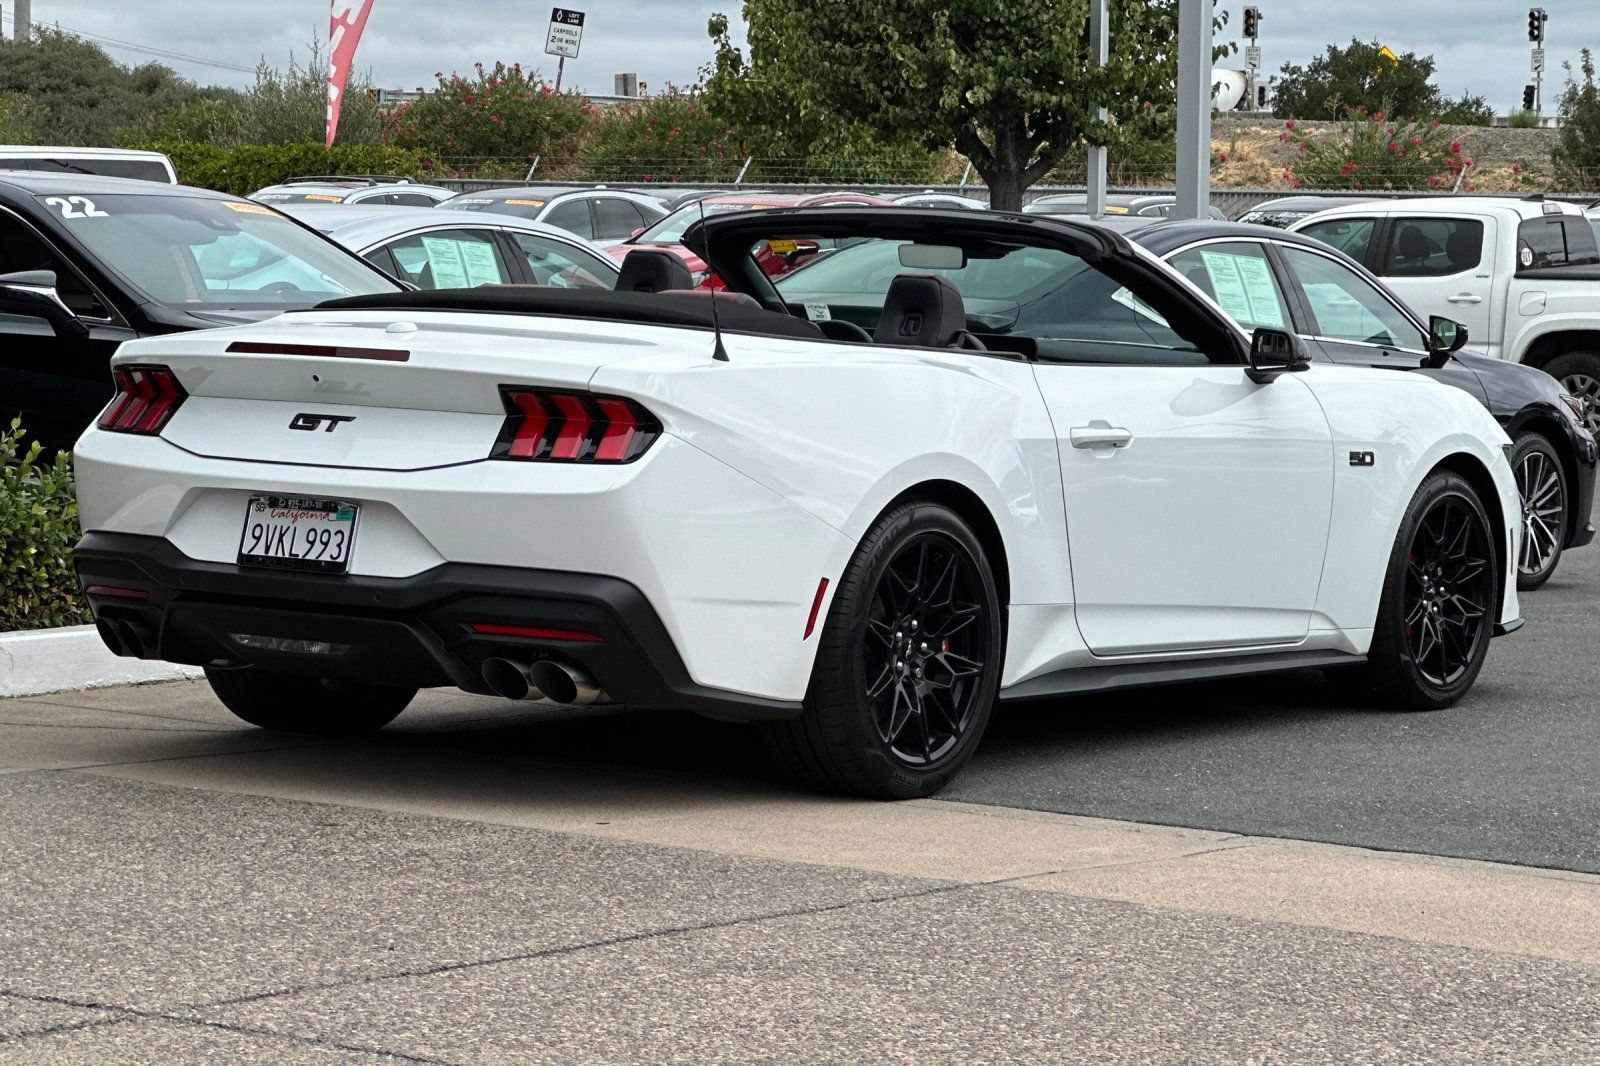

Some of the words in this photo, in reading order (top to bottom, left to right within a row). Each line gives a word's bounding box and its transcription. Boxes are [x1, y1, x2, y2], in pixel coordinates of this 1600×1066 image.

[553, 27, 578, 36] CARPOOLS
[44, 195, 109, 219] 22
[289, 413, 357, 432] GT
[270, 507, 330, 523] California
[247, 523, 345, 560] 9VKL993
